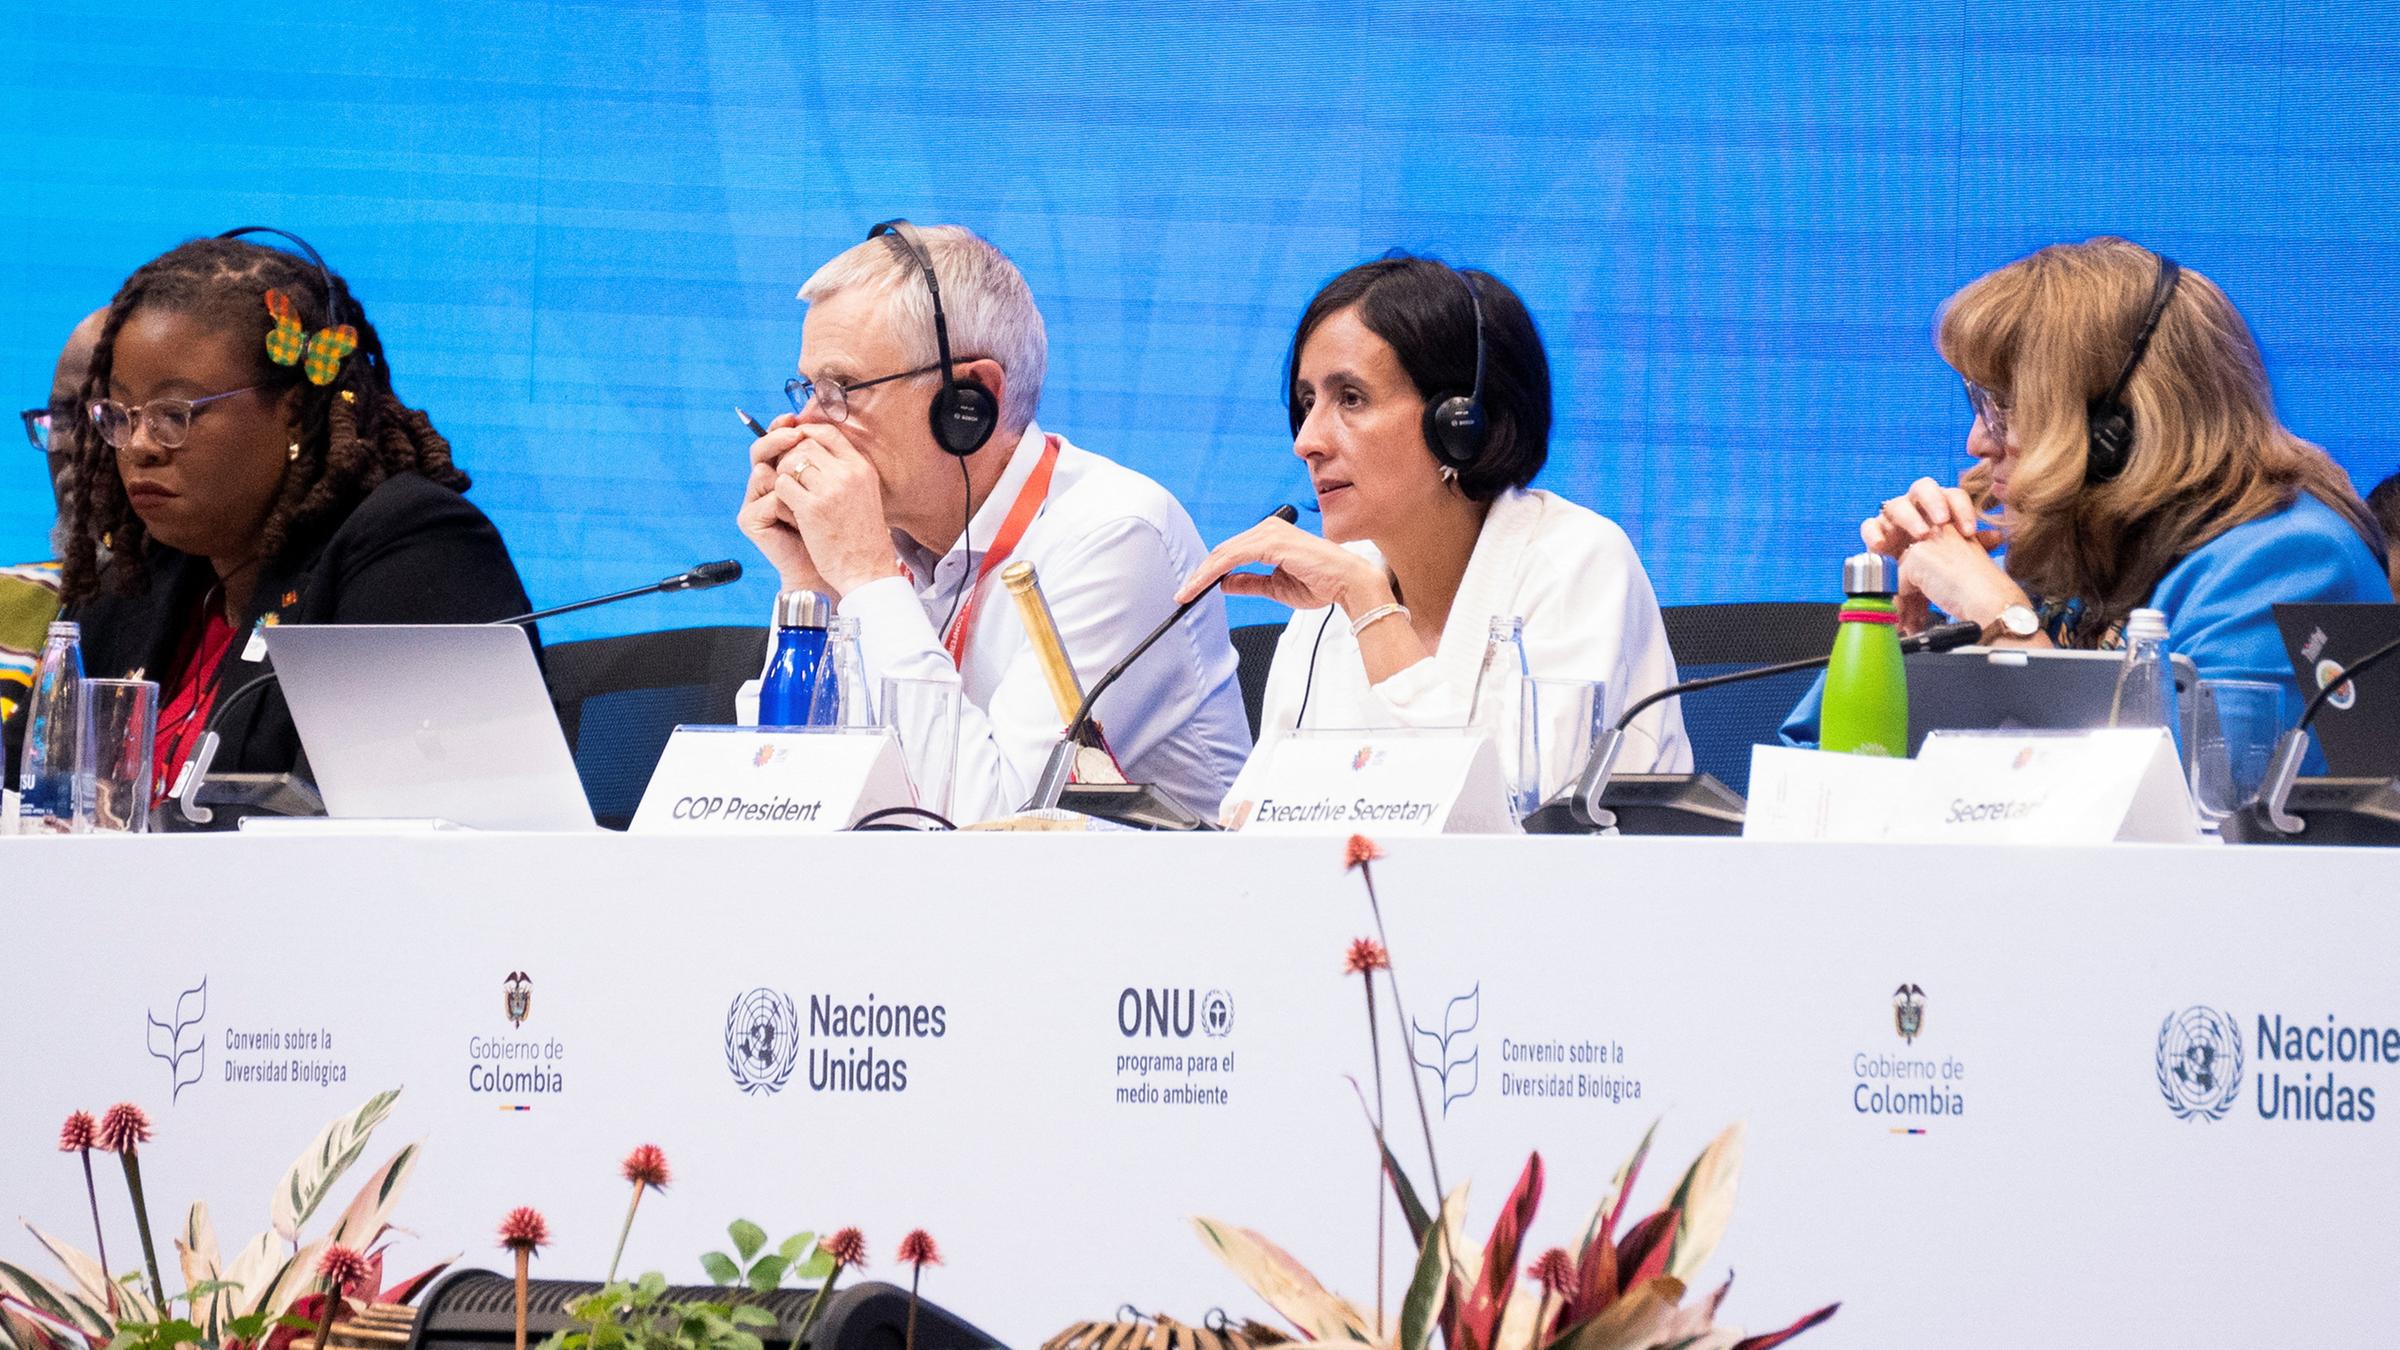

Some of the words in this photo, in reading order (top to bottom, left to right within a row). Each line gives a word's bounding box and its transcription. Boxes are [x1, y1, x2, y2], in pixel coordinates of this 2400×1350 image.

[672, 796, 723, 820] COP
[723, 795, 822, 822] President
[1256, 798, 1347, 822] Executive
[1348, 798, 1439, 825] Secretary
[809, 992, 947, 1039] Naciones
[1117, 986, 1196, 1040] ONU
[225, 1027, 281, 1051] Convenio
[283, 1027, 318, 1051] sobre
[320, 1027, 332, 1050] la
[469, 1035, 540, 1060] Gobierno
[544, 1036, 564, 1061] de
[1502, 1037, 1565, 1063] Convenio
[1569, 1039, 1608, 1064] sobre
[1611, 1039, 1624, 1065] la
[2256, 1012, 2400, 1065] Nacione
[224, 1059, 288, 1083] Diversidad
[291, 1059, 347, 1088] Biológica
[468, 1063, 563, 1094] Colombia
[808, 1045, 908, 1093] Unidas
[1116, 1054, 1184, 1077] programa
[1186, 1055, 1218, 1078] para
[1221, 1050, 1235, 1073] el
[1853, 1052, 1936, 1080] Gobierno
[1941, 1055, 1964, 1081] de
[1115, 1081, 1160, 1104] medio
[1162, 1082, 1229, 1106] ambiente
[1501, 1071, 1574, 1098] Diversidad
[1578, 1073, 1642, 1105] Biológica
[1853, 1082, 1964, 1117] Colombia
[2256, 1071, 2376, 1124] Unidas
